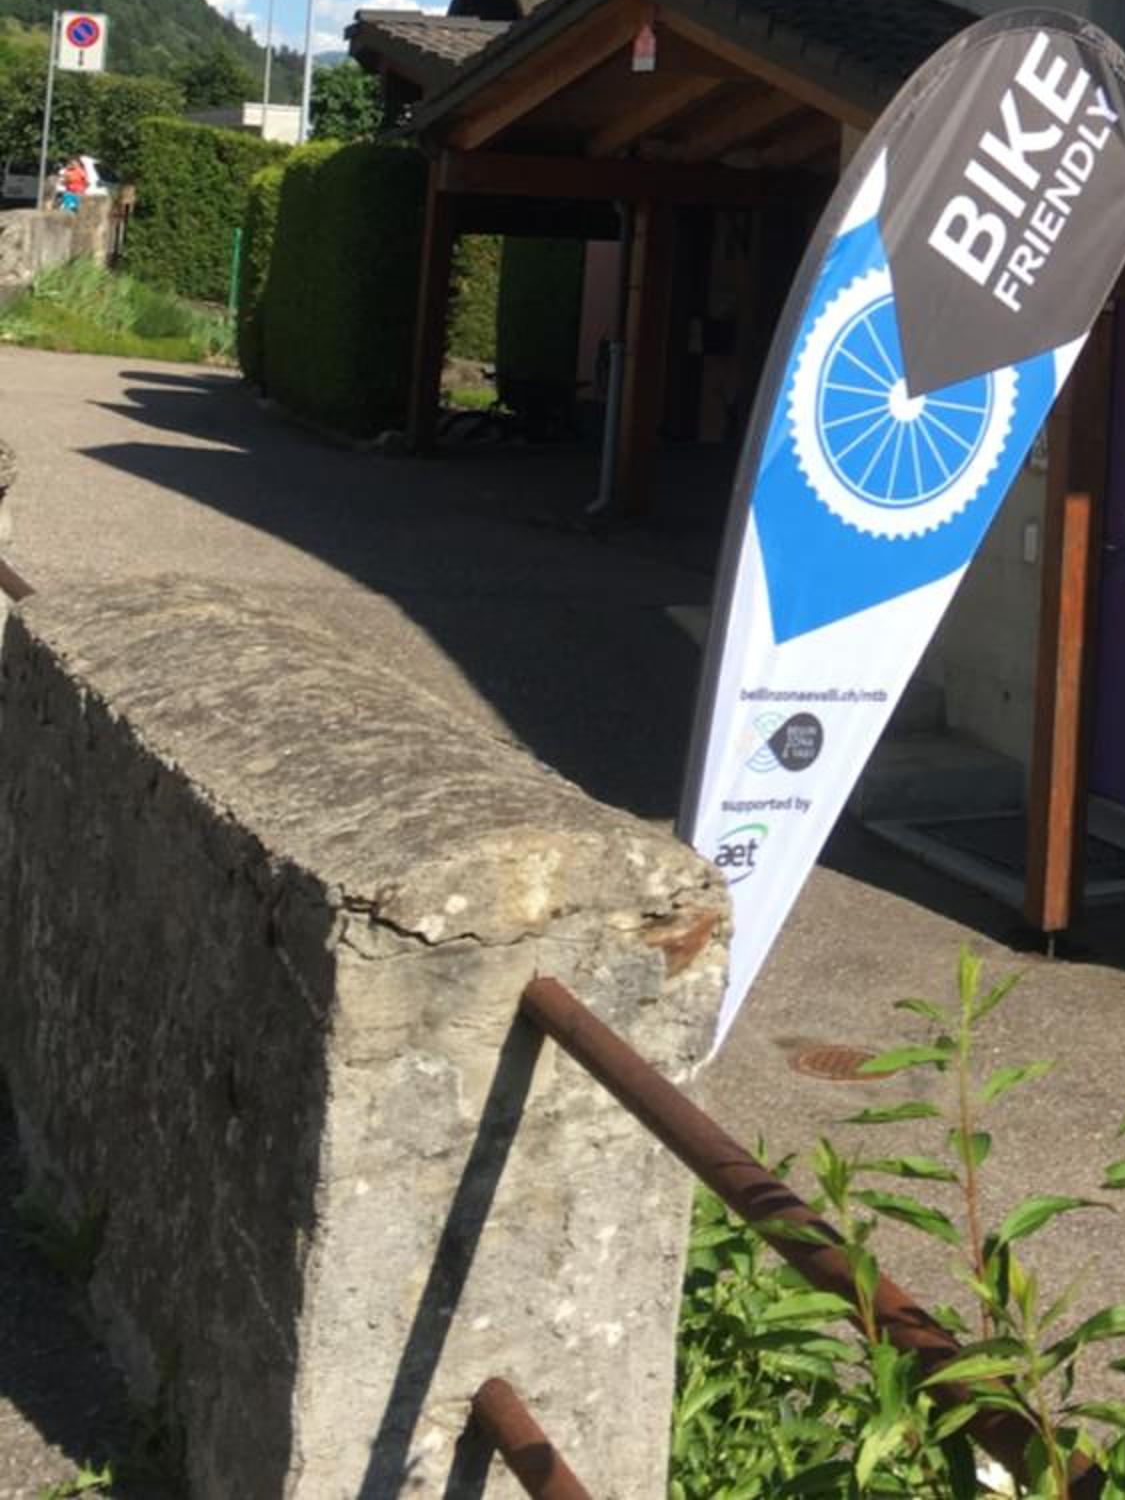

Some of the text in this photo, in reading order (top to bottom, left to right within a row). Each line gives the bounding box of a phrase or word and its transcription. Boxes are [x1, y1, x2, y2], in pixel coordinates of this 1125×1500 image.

[928, 32, 1090, 285] BIKE
[993, 86, 1118, 312] FRIENDLY
[714, 838, 758, 868] aet
[721, 797, 812, 813] supported by
